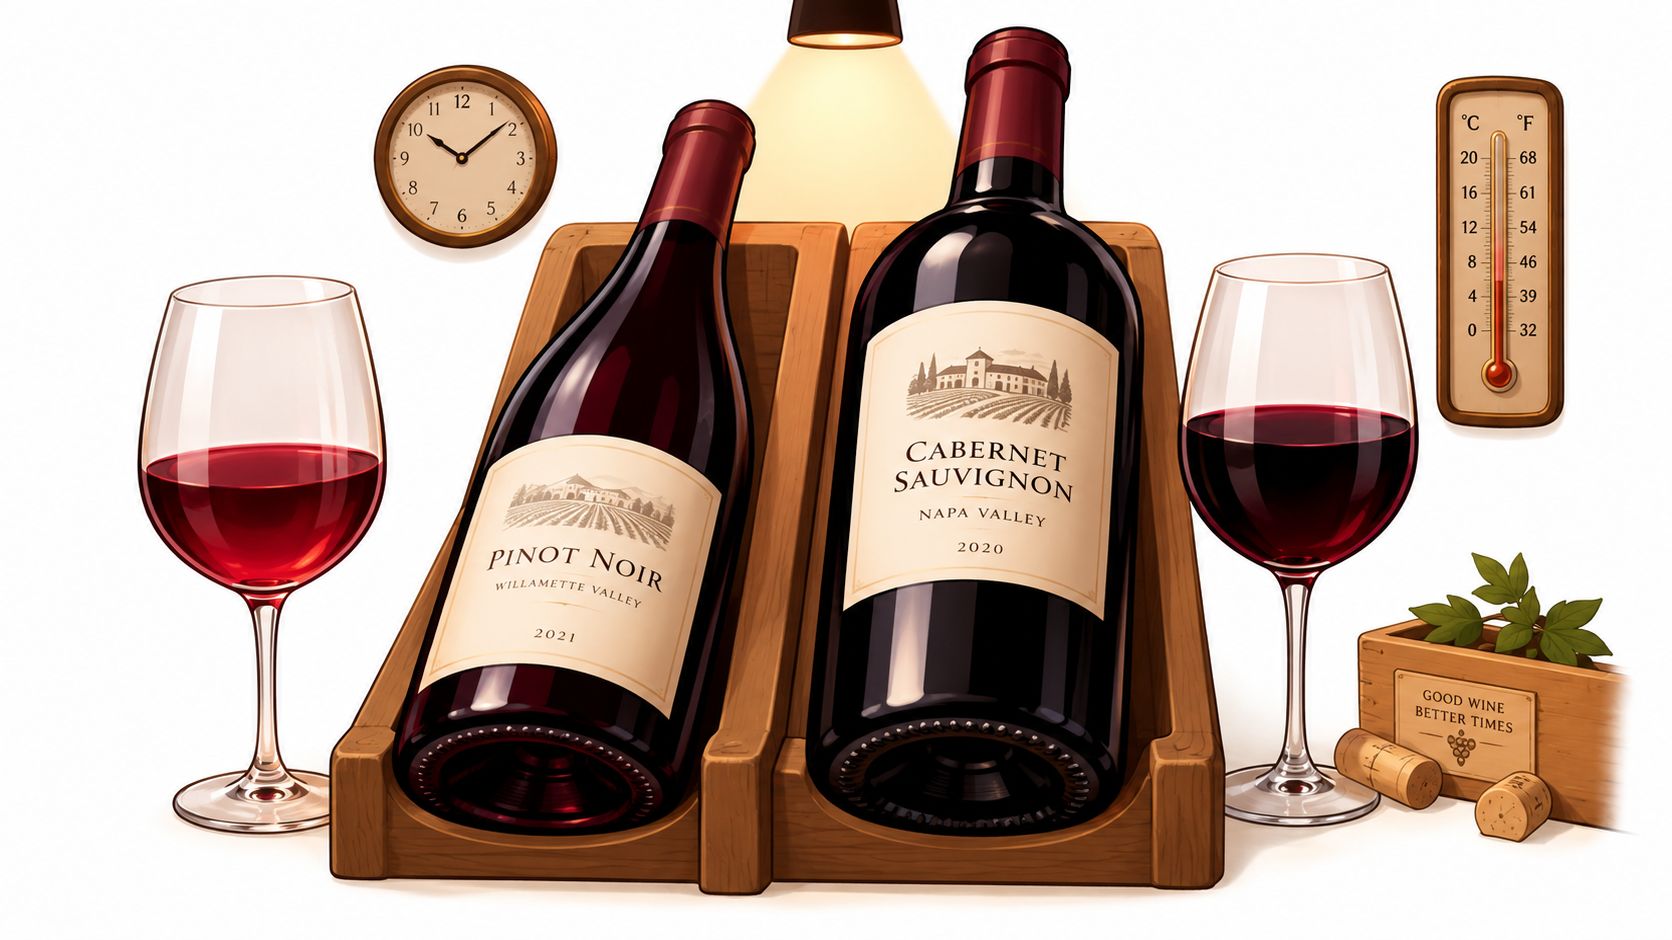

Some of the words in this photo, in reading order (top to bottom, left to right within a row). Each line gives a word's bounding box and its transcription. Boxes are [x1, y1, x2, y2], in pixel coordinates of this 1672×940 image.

[454, 94, 470, 109] 12
[429, 102, 440, 116] 11
[407, 122, 423, 136] 10
[508, 122, 517, 136] 2
[400, 151, 409, 165] 9
[516, 151, 525, 166] 3
[1460, 152, 1478, 164] 20
[1519, 152, 1537, 164] 68
[408, 180, 418, 195] 8
[507, 180, 517, 194] 4
[1461, 185, 1478, 199] 16
[1519, 185, 1535, 199] 61
[430, 201, 439, 215] 7
[486, 201, 496, 215] 5
[457, 208, 467, 223] 6
[1462, 221, 1478, 234] 12
[1519, 221, 1537, 234] 54
[1467, 255, 1477, 268] 8
[1519, 255, 1537, 268] 46
[1467, 290, 1477, 302] 4
[1519, 290, 1537, 303] 39
[1467, 324, 1477, 337] 0
[1519, 324, 1537, 337] 32
[906, 440, 1067, 473] CABERNET
[894, 467, 1073, 504] SAUVIGNON
[919, 507, 969, 521] NAPA
[978, 507, 1046, 528] VALLEY
[957, 541, 1004, 555] 2020
[486, 546, 580, 571] PINOT
[590, 548, 664, 593] NOIR
[495, 579, 585, 592] WILLAMETTE
[592, 584, 642, 609] VALLEY
[534, 628, 575, 643] 2021
[1423, 689, 1463, 706] GOOD
[1468, 697, 1505, 714] WINE
[1415, 705, 1466, 725] BETTER
[1471, 716, 1513, 734] TIMES
